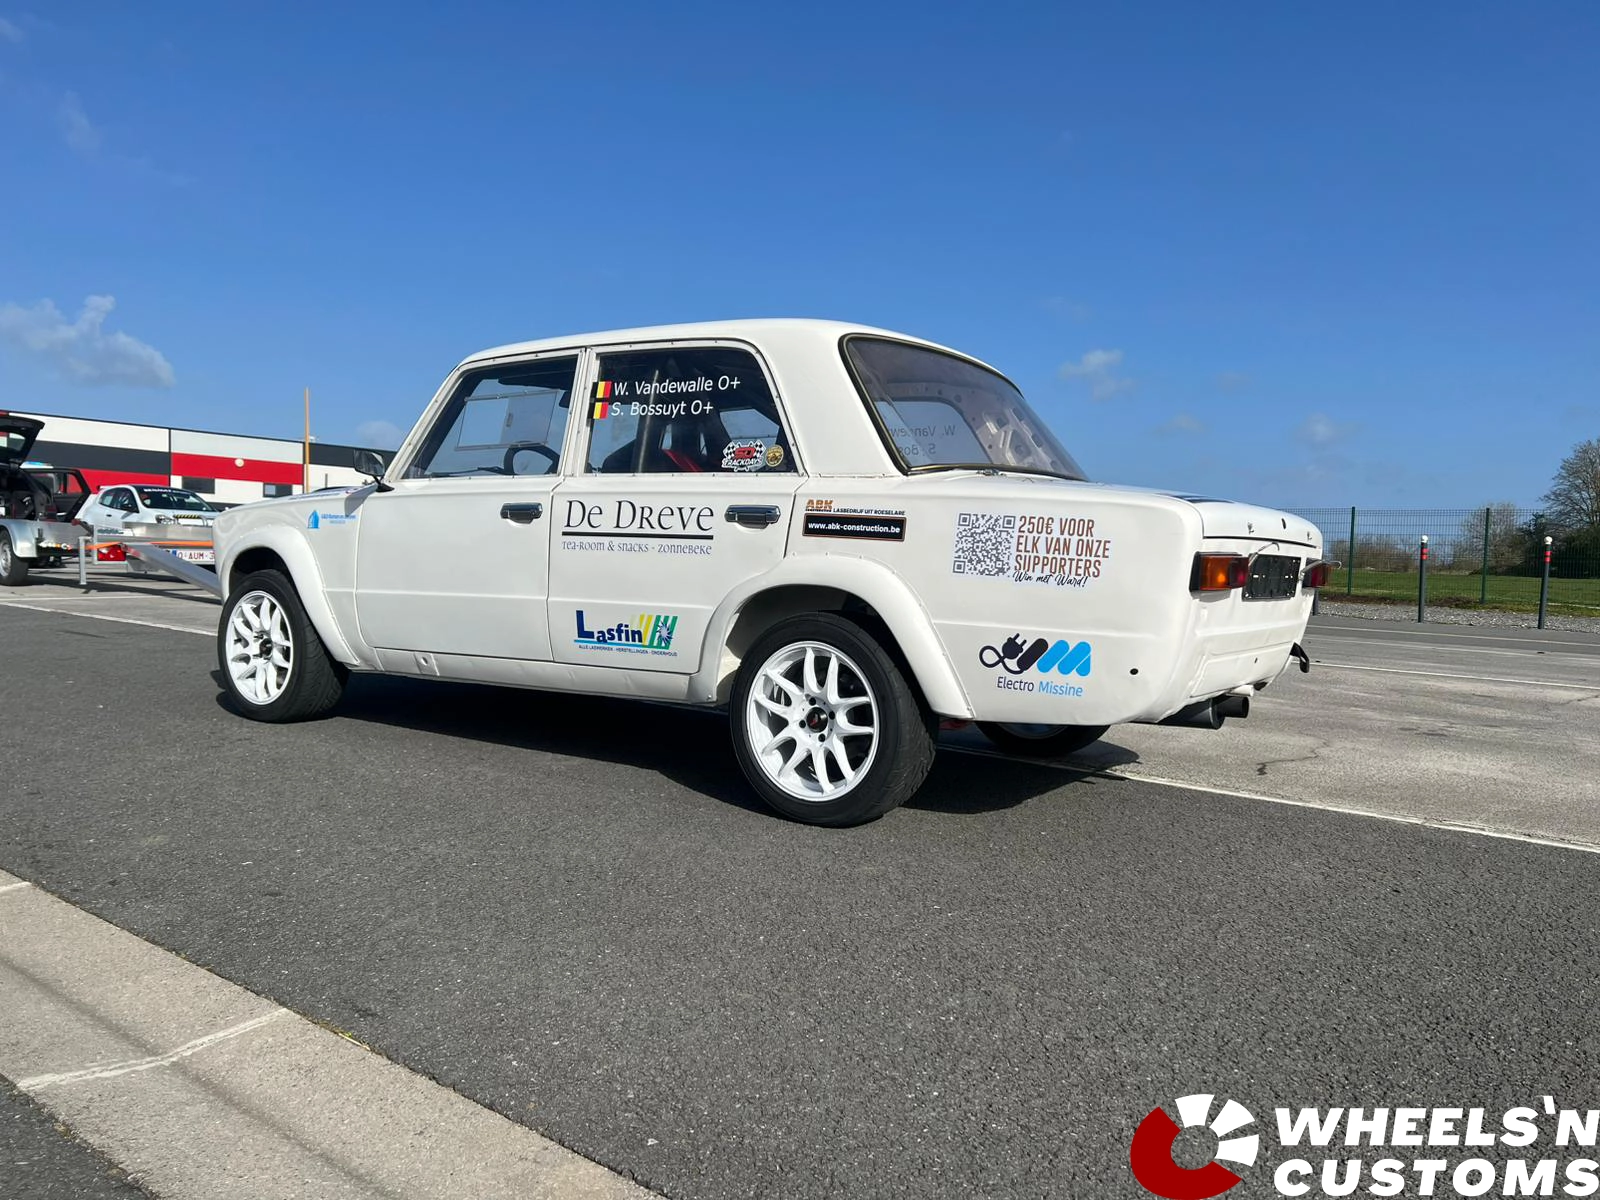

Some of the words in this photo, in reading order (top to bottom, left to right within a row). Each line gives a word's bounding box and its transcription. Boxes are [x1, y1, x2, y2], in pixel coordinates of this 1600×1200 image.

[614, 382, 629, 396] W.
[635, 377, 713, 395] Vandewalle
[718, 375, 741, 390] O+
[611, 402, 624, 416] S.
[630, 401, 686, 418] Bossuyt
[691, 400, 714, 415] O+
[808, 522, 901, 533] www.abk-construction.be
[1018, 515, 1054, 535] 250€
[1059, 517, 1095, 537] VOOR
[607, 540, 615, 552] &
[1016, 535, 1042, 554] ELK
[1045, 537, 1071, 556] VAN
[1076, 539, 1111, 559] ONZE
[1014, 554, 1102, 578] SUPPORTERS
[1012, 571, 1033, 582] Win
[1036, 574, 1053, 584] met
[576, 610, 643, 643] Lasfin
[996, 676, 1035, 692] Electro
[1038, 680, 1084, 697] Missine
